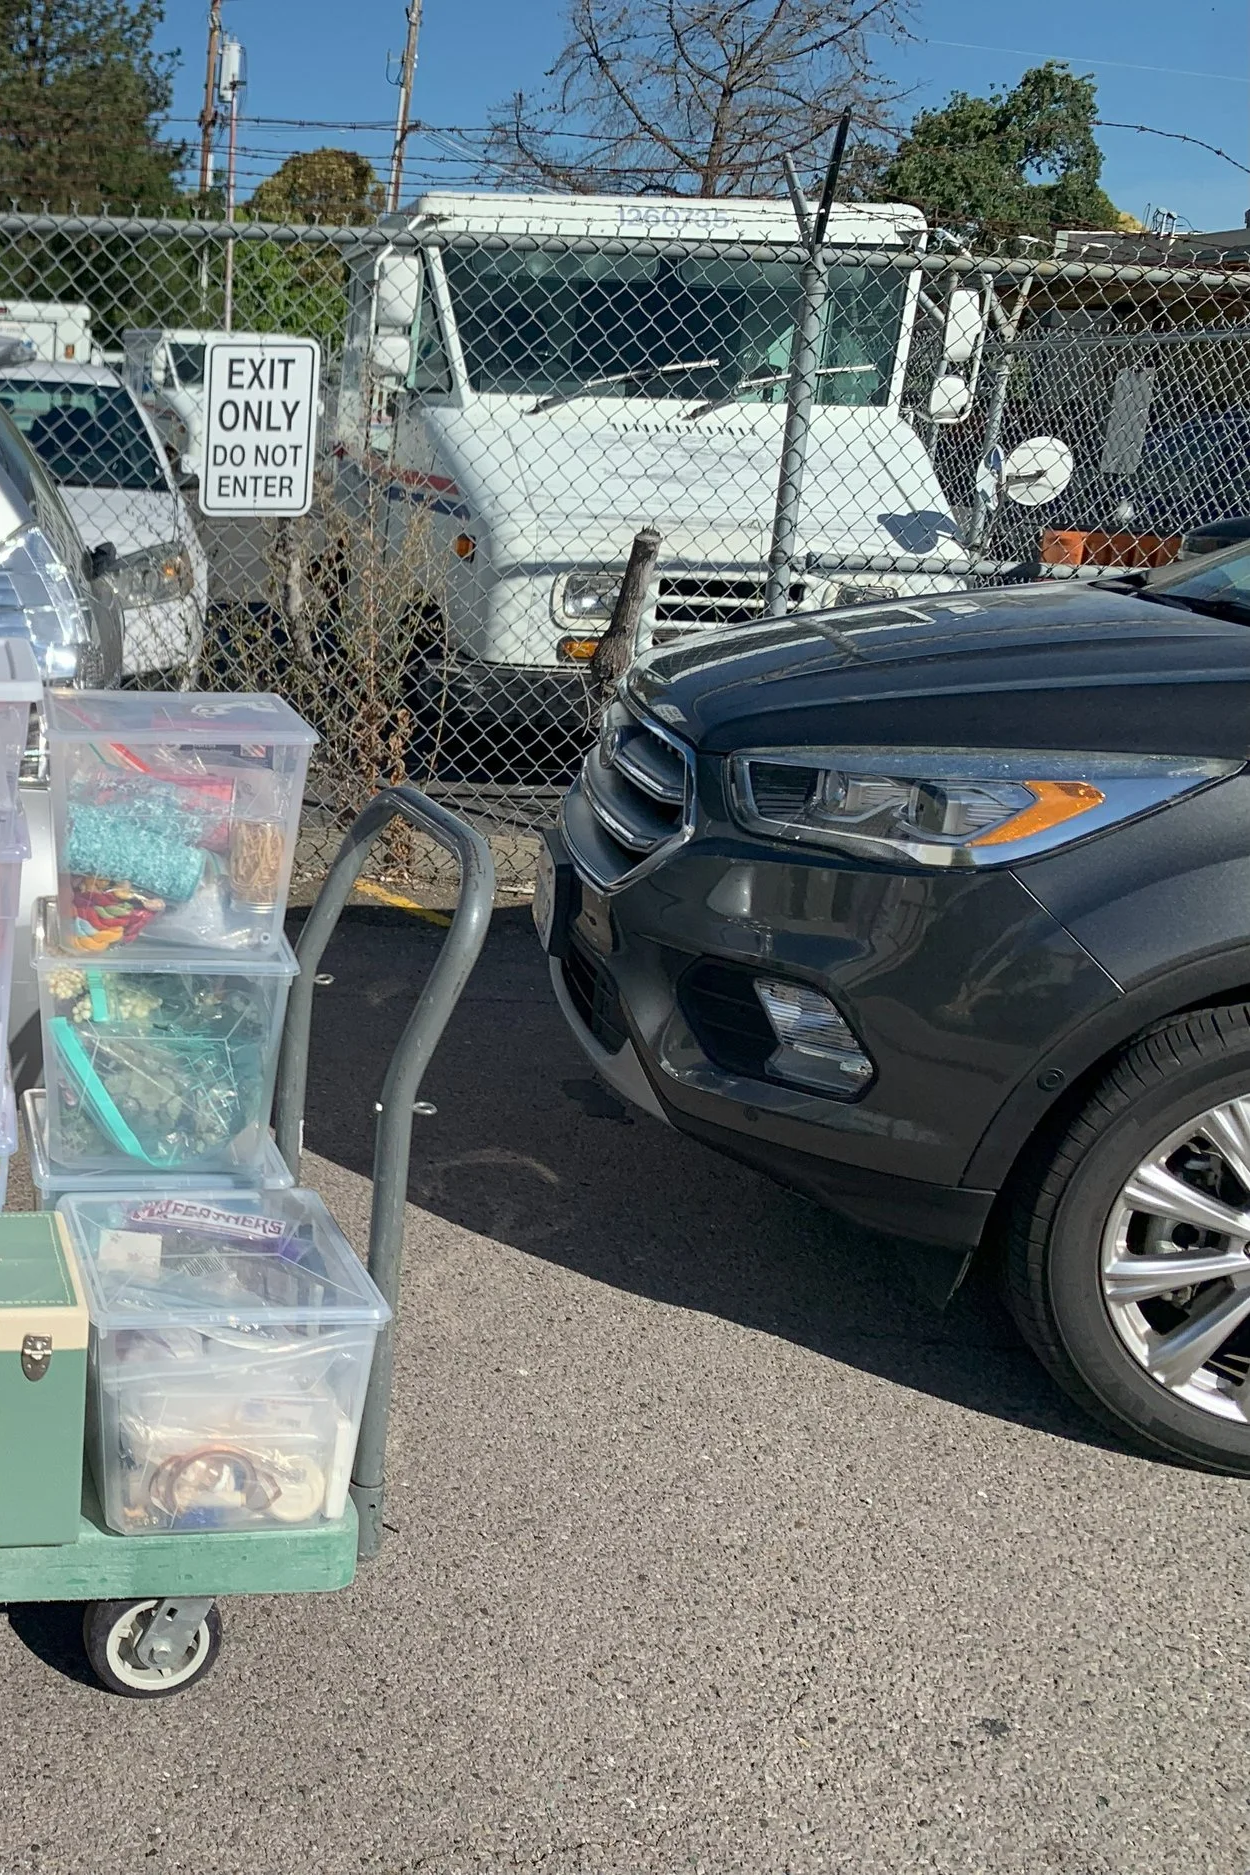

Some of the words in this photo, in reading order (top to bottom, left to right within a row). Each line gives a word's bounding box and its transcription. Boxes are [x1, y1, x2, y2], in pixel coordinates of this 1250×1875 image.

[615, 206, 730, 229] 1260735
[227, 358, 296, 390] EXIT
[218, 400, 300, 432] ONLY
[213, 445, 246, 467] DO
[254, 444, 303, 467] NOT
[218, 475, 294, 498] ENTER
[171, 1201, 283, 1235] FEATHERS
